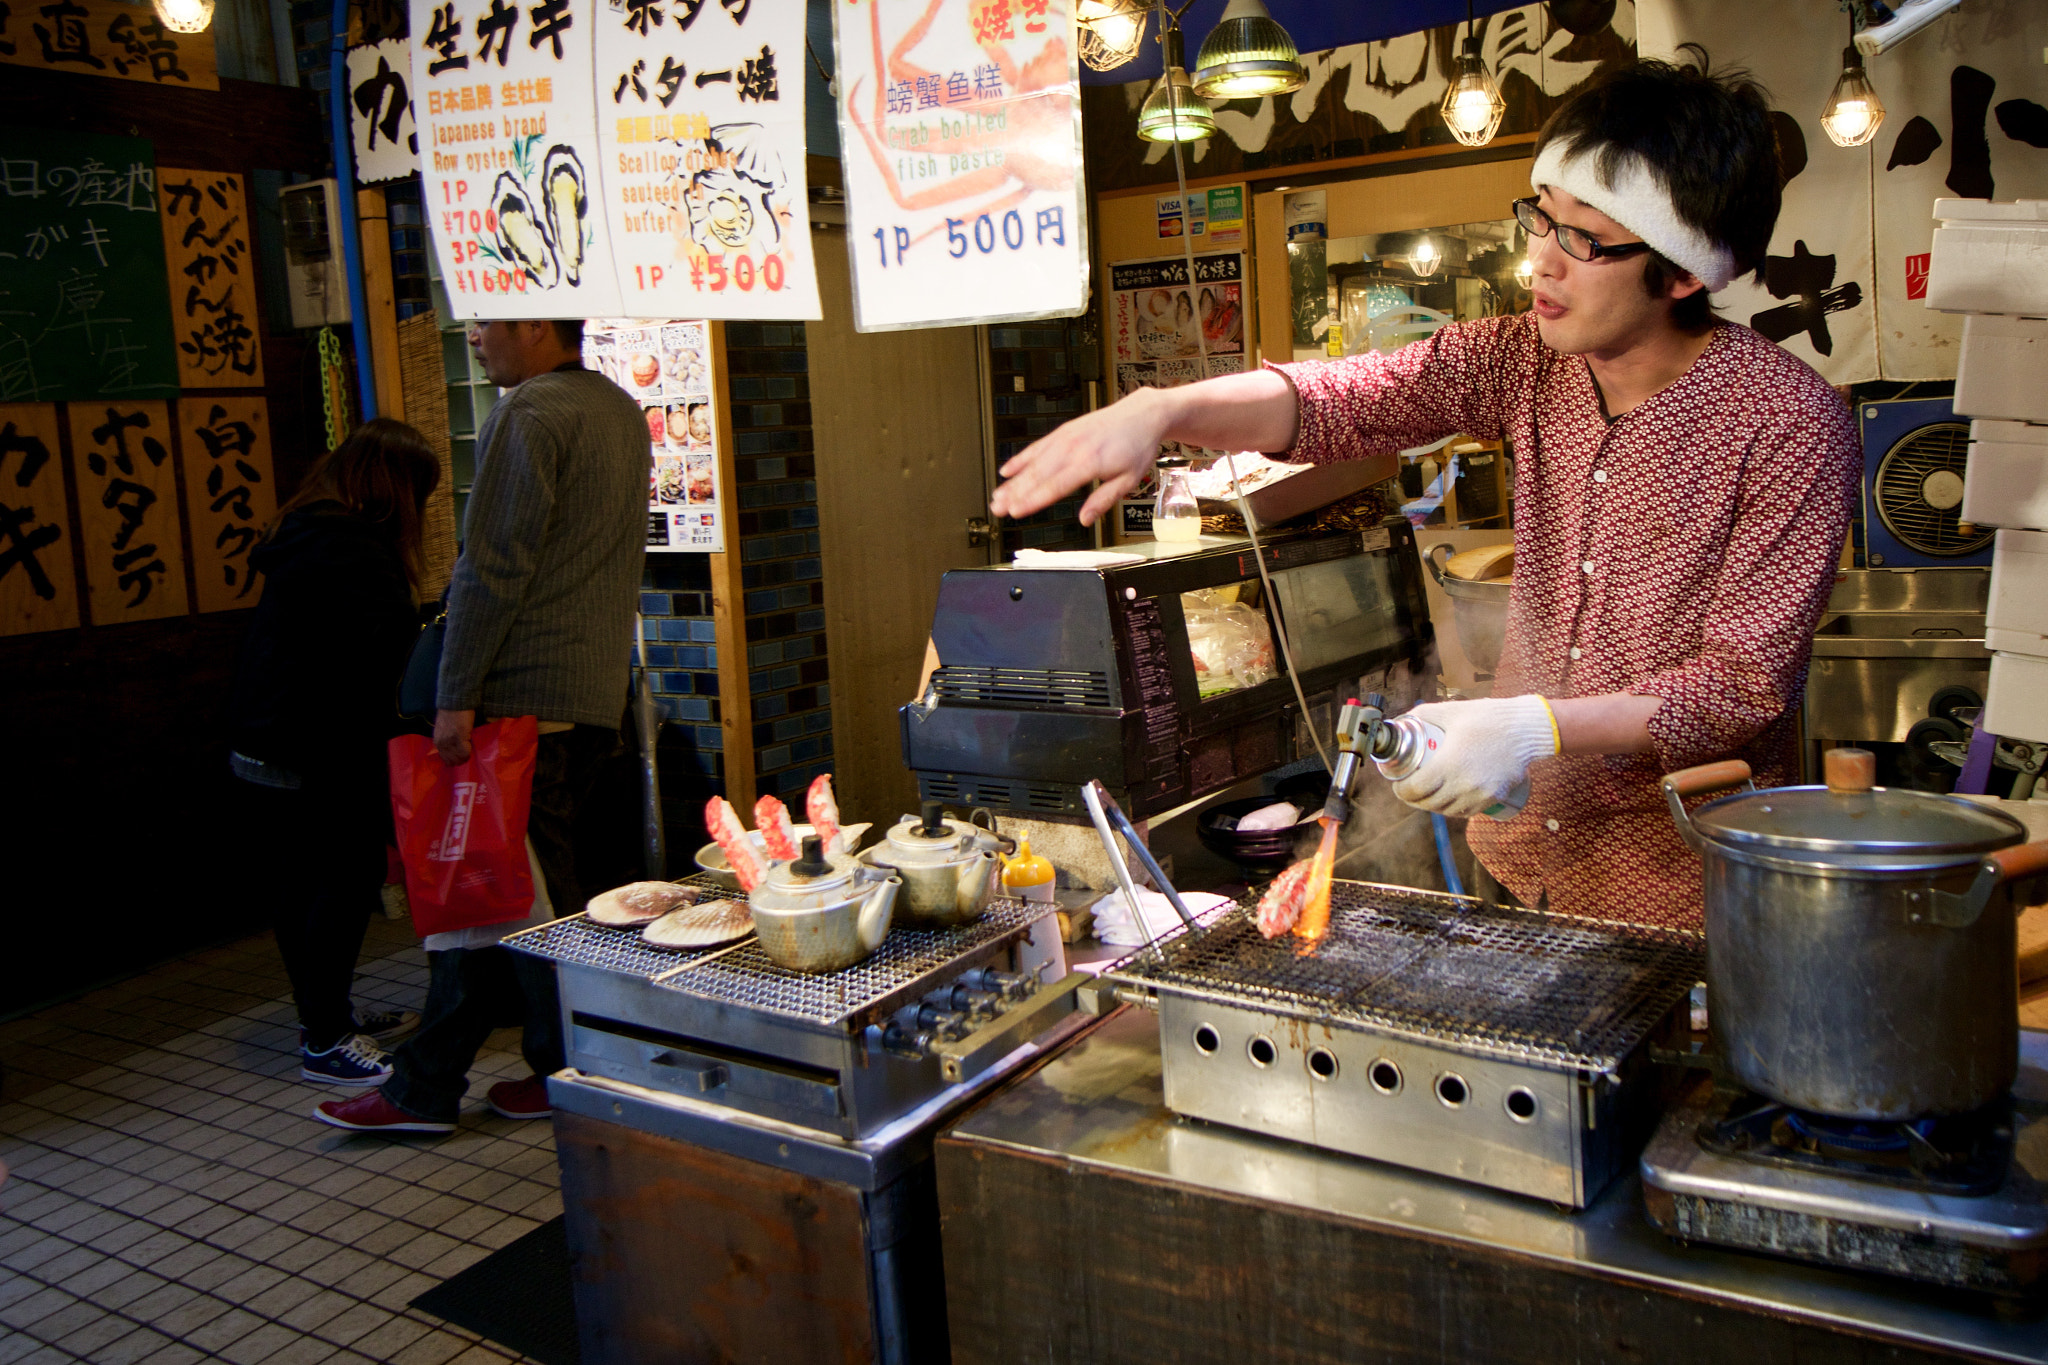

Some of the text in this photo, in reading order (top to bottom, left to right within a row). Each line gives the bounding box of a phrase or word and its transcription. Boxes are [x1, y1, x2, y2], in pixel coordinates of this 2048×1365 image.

[0, 0, 189, 82] 直結
[424, 0, 573, 77] 生カキ
[613, 44, 779, 109] バター焼
[887, 62, 1003, 114] 螃蟹鱼糕
[428, 83, 492, 115] 日本品牌
[503, 110, 547, 138] brand
[888, 105, 1007, 149] Crab boiled
[434, 146, 515, 173] Row oyster
[619, 146, 738, 174] Scallop dishes
[898, 144, 1003, 181] fish paste
[443, 180, 468, 205] 1P
[622, 180, 704, 203] sauteed in
[1161, 200, 1181, 211] VISA
[443, 208, 497, 235] ¥700
[624, 210, 672, 233] butter
[873, 206, 1065, 268] 1P 500円
[0, 219, 111, 268] がキ
[451, 240, 480, 264] 3P
[163, 176, 257, 376] がんがん焼
[456, 267, 527, 294] ¥1600
[636, 254, 785, 293] 1P ¥500
[87, 408, 168, 608] ホタテ
